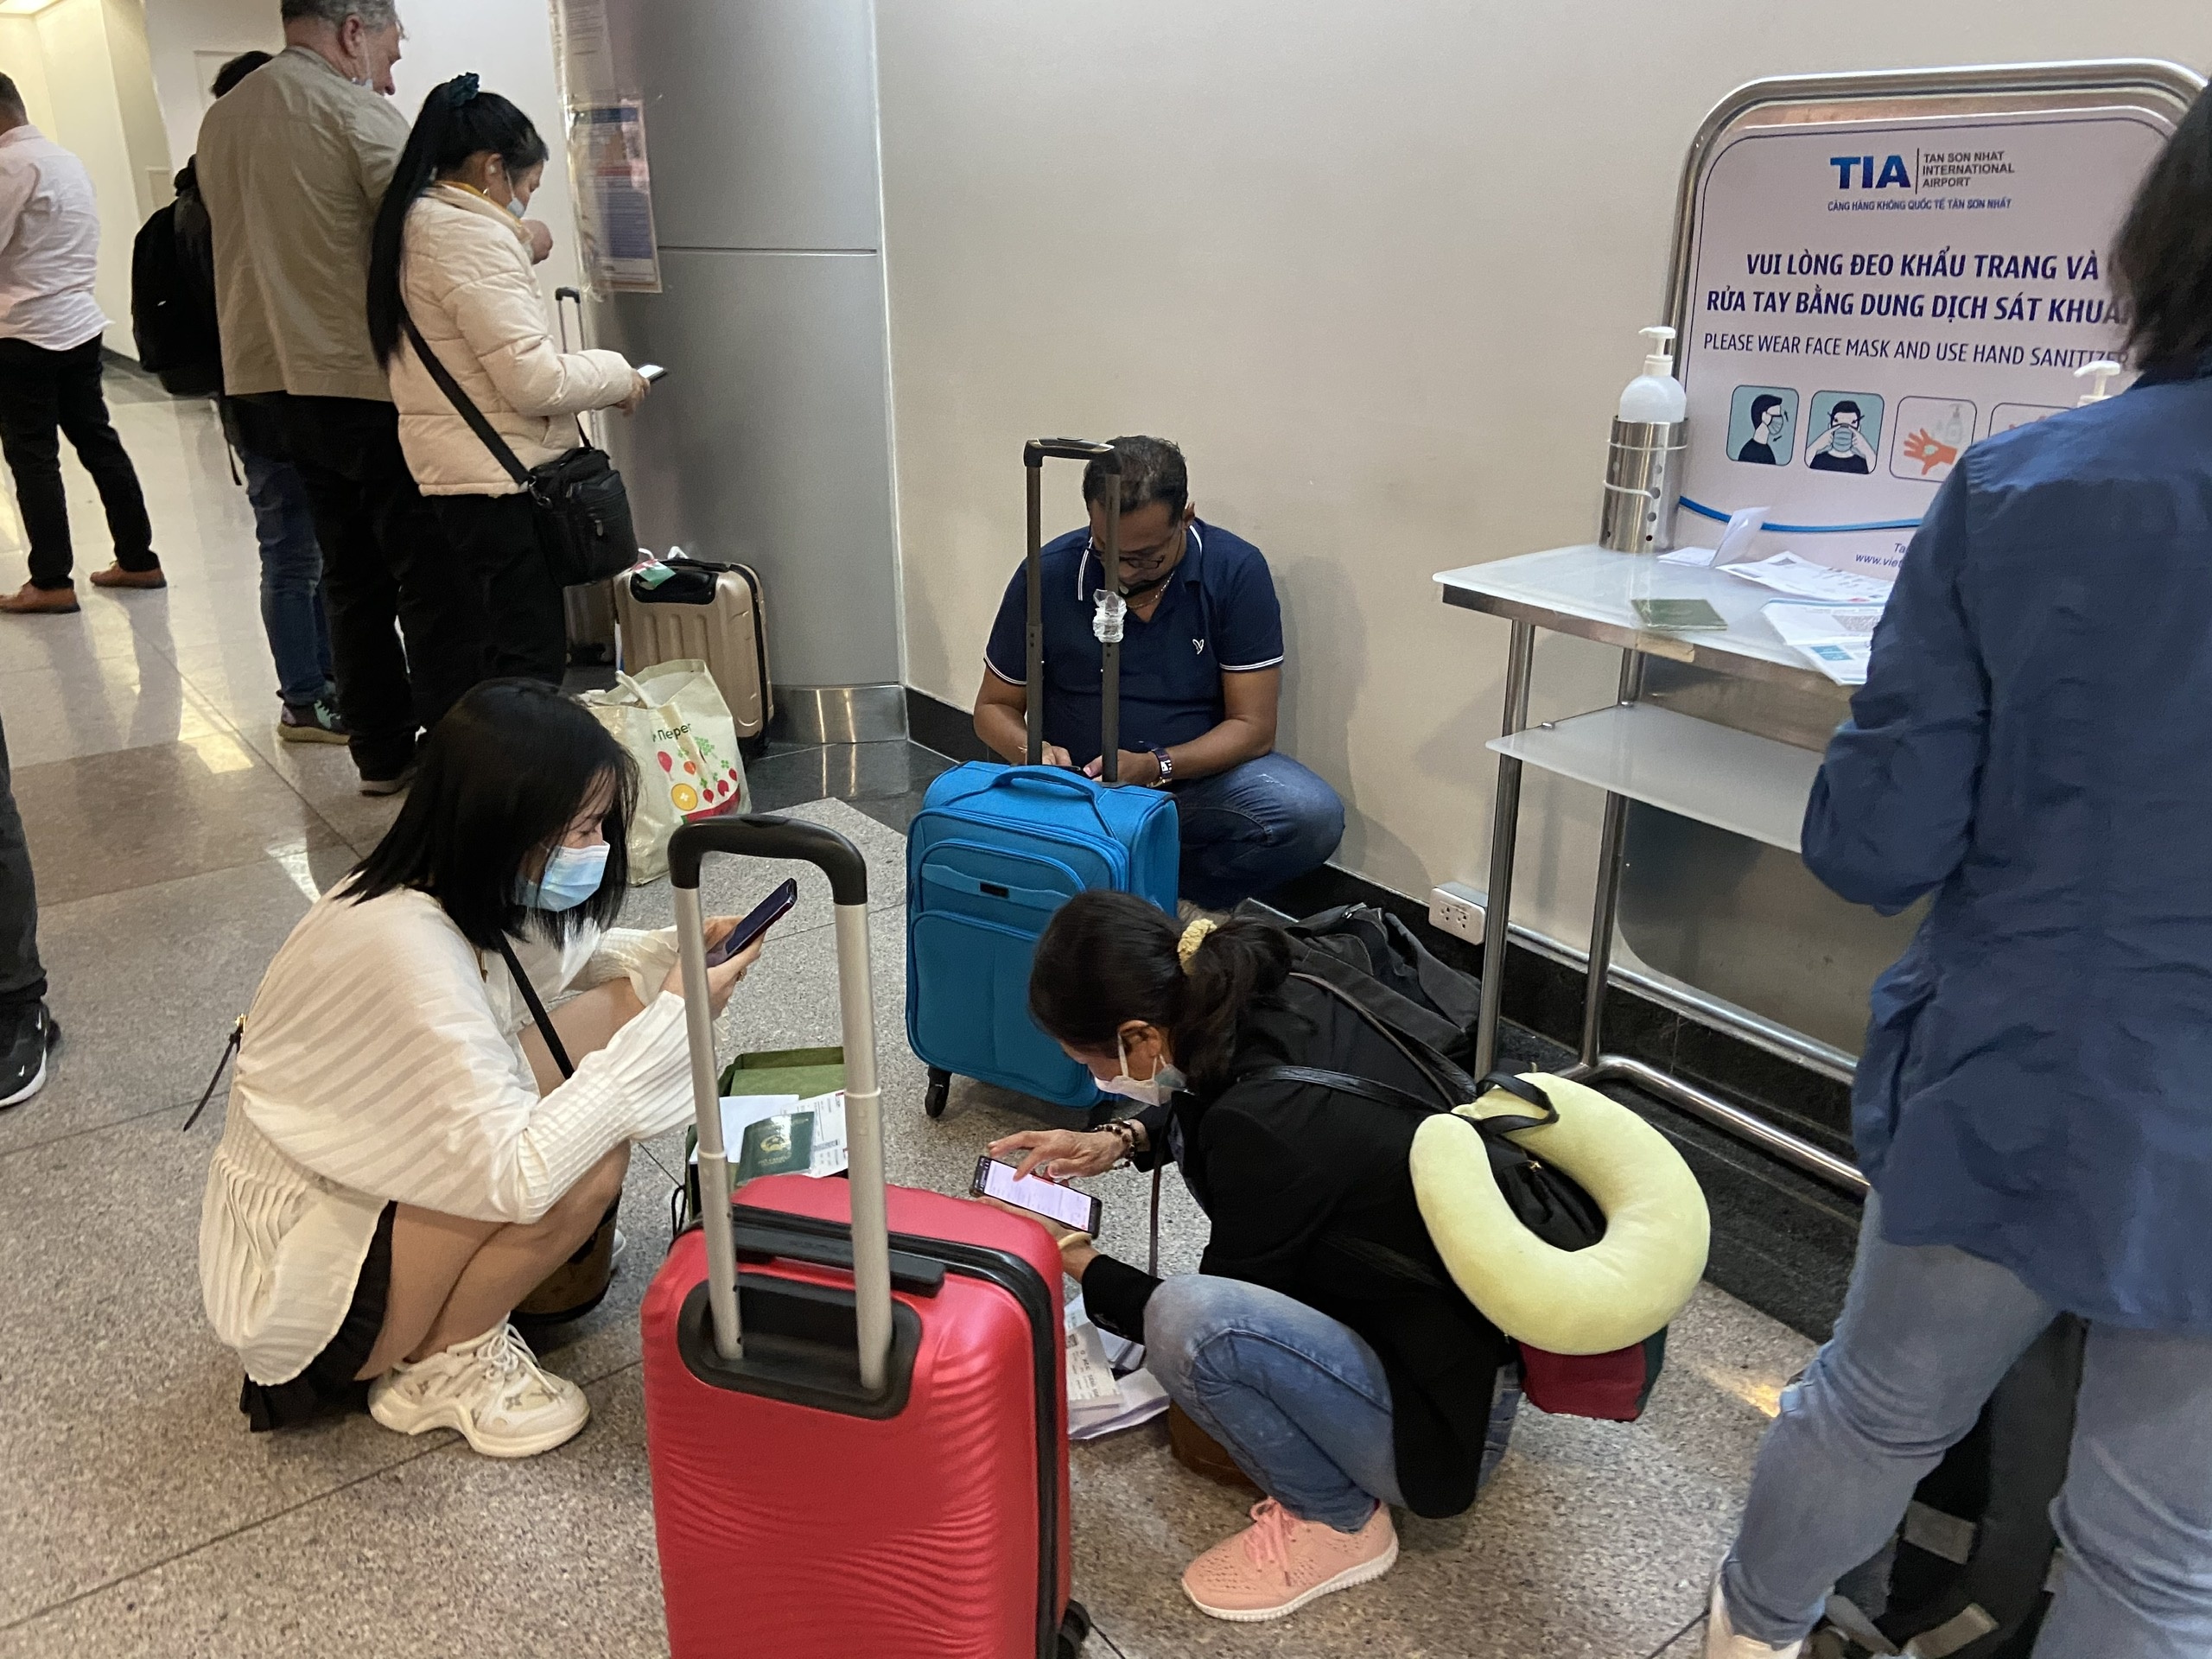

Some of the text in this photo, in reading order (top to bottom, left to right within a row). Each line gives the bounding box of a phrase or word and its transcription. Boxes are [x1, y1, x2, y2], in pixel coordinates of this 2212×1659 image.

[1830, 155, 1911, 189] TIA
[1923, 150, 2005, 163] TAN SON NHAT
[1923, 163, 2015, 176] INTERNATIONAL
[1923, 177, 1971, 188] AIRPORT
[1746, 253, 1783, 276] VUI
[1787, 248, 1844, 276] LÒNG
[1850, 253, 1895, 276] ĐEO
[1974, 254, 2057, 280] TRANG
[2066, 250, 2099, 280] VÀ
[1707, 285, 1746, 312] RỬA
[1752, 290, 1792, 313] TAY
[1796, 283, 1854, 315] BẰNG
[1860, 293, 1925, 317] DUNG
[1931, 294, 1988, 323] DỊCH
[1993, 291, 2043, 321] SÁT
[1704, 333, 1754, 352] PLEASE
[1758, 334, 1801, 354] WEAR
[1805, 336, 1842, 356] FACE
[1846, 339, 1891, 359] MASK
[1893, 340, 1930, 360] AND
[1936, 342, 1969, 362] USE
[1973, 344, 2024, 365] HAND
